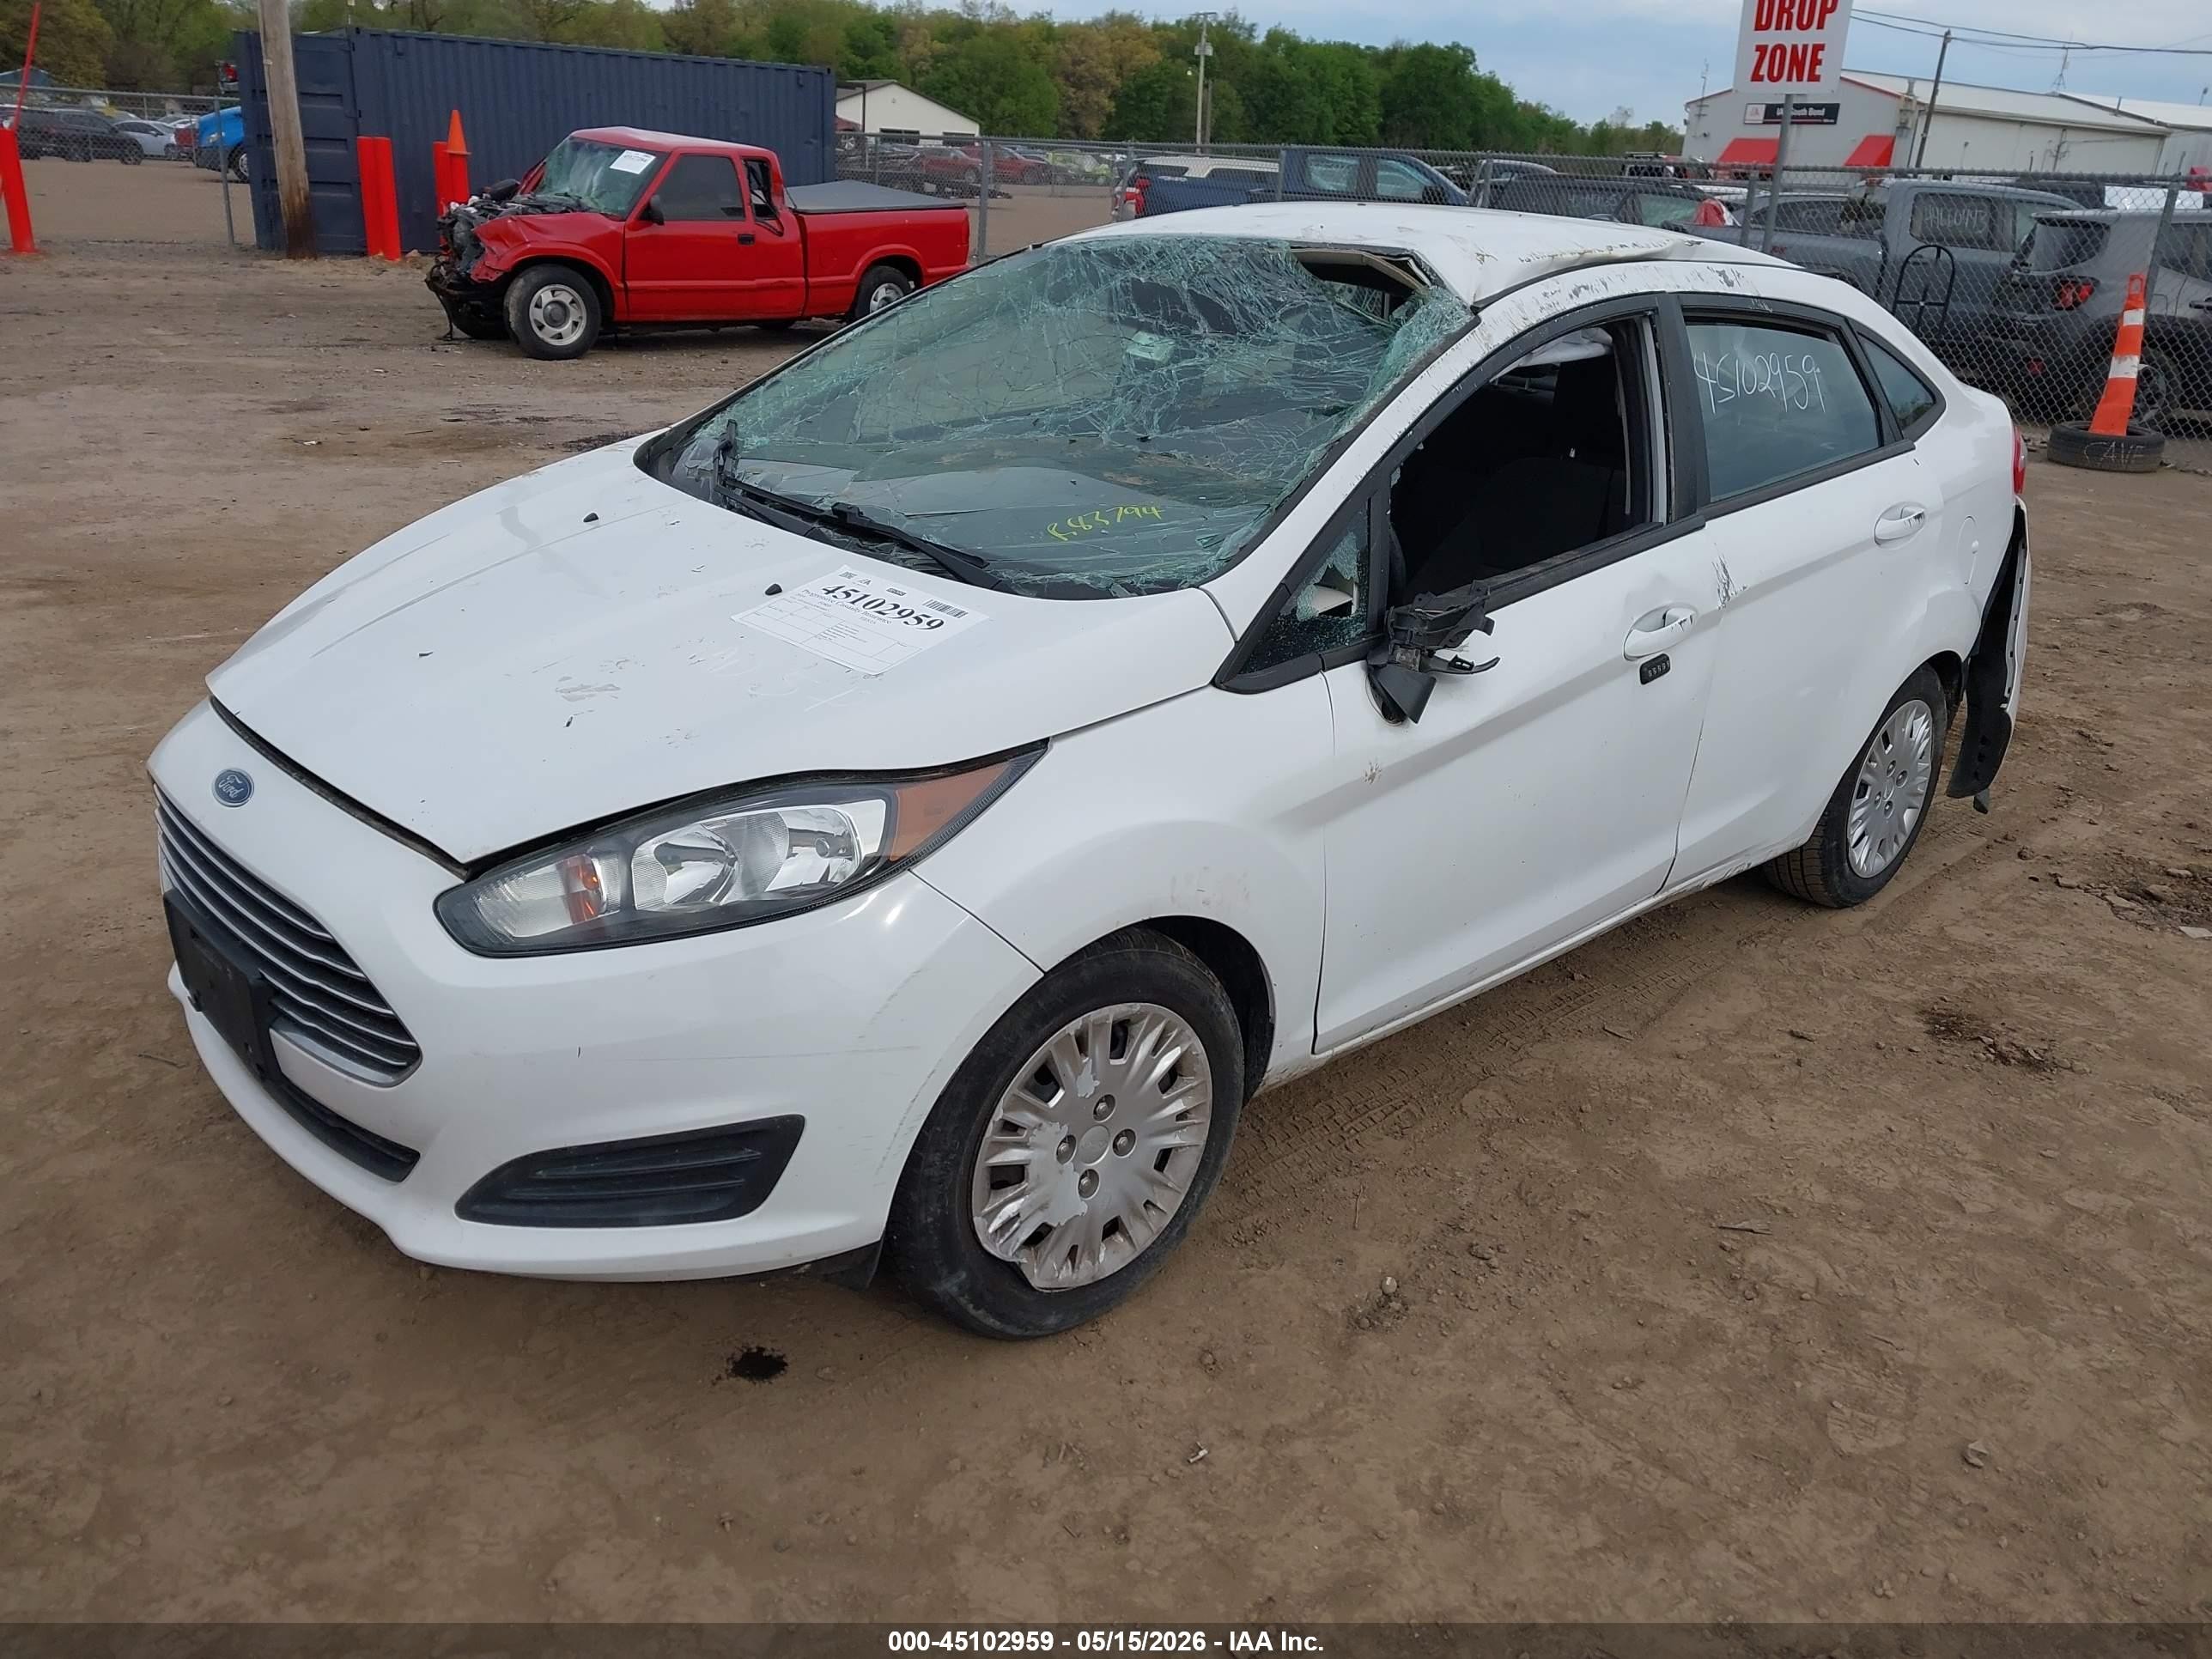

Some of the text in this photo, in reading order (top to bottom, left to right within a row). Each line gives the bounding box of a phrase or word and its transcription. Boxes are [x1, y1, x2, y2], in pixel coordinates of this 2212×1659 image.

[1754, 0, 1838, 31] DROP
[1750, 43, 1826, 82] ZONE
[1694, 352, 1826, 414] 45102959
[822, 585, 945, 630] 45102959
[218, 775, 245, 798] Ford
